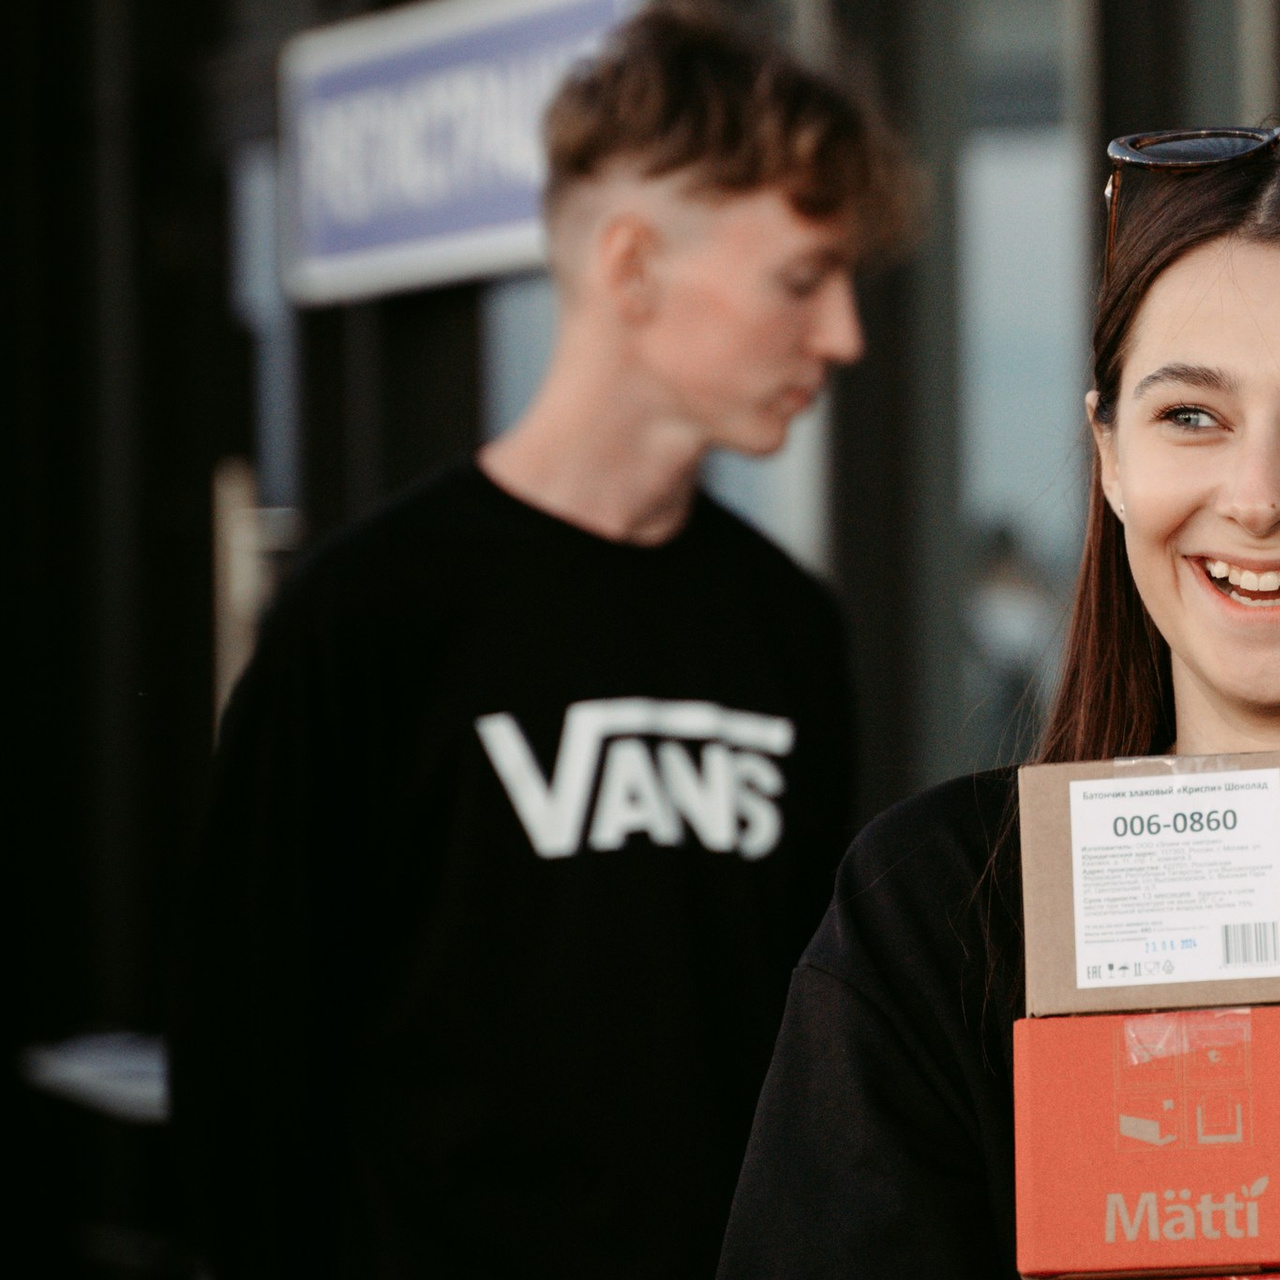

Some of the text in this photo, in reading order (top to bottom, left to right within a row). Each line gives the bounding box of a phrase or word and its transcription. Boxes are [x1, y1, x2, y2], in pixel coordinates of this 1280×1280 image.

[475, 696, 795, 859] VANS
[1082, 789, 1126, 800] Батончик
[1129, 786, 1173, 796] злаковый
[1225, 780, 1269, 792] Шоколад
[1112, 808, 1238, 837] 006-0860
[1105, 1177, 1268, 1243] Mätti
